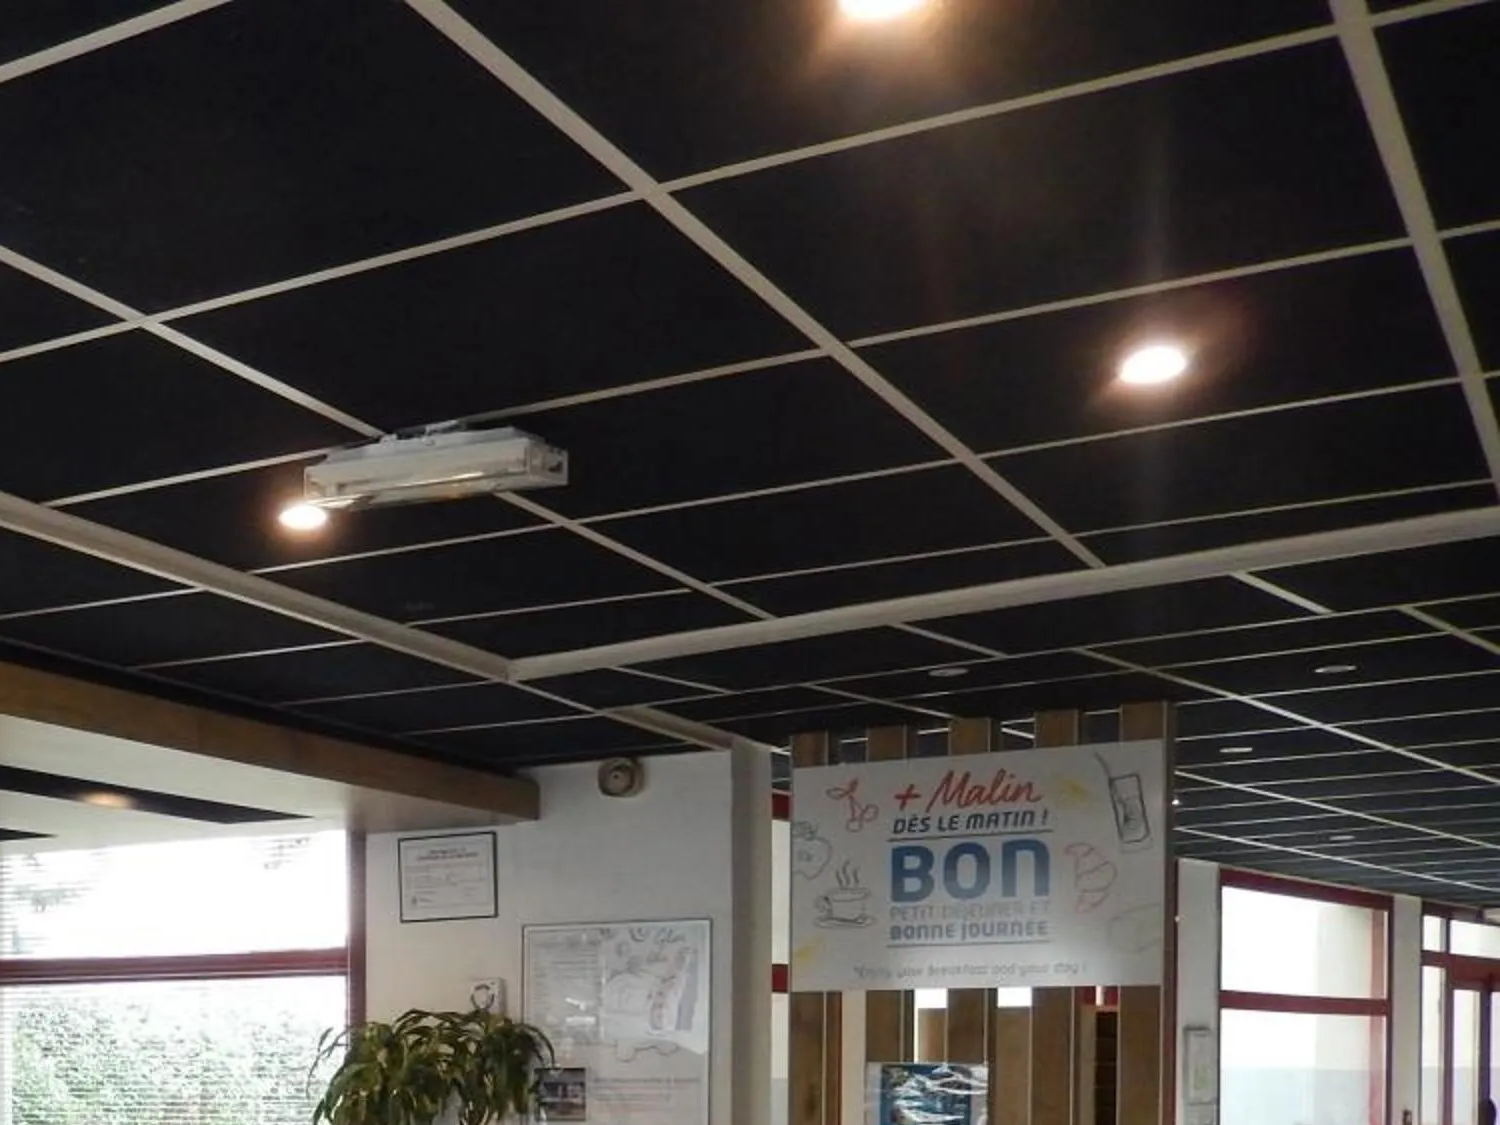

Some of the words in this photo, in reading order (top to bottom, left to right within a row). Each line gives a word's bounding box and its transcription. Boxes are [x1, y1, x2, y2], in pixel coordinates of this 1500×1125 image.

[925, 767, 1044, 813] Malin
[937, 813, 960, 833] LE
[965, 809, 1036, 830] MATIN
[890, 838, 1051, 903] BON
[889, 922, 957, 941] BONNE
